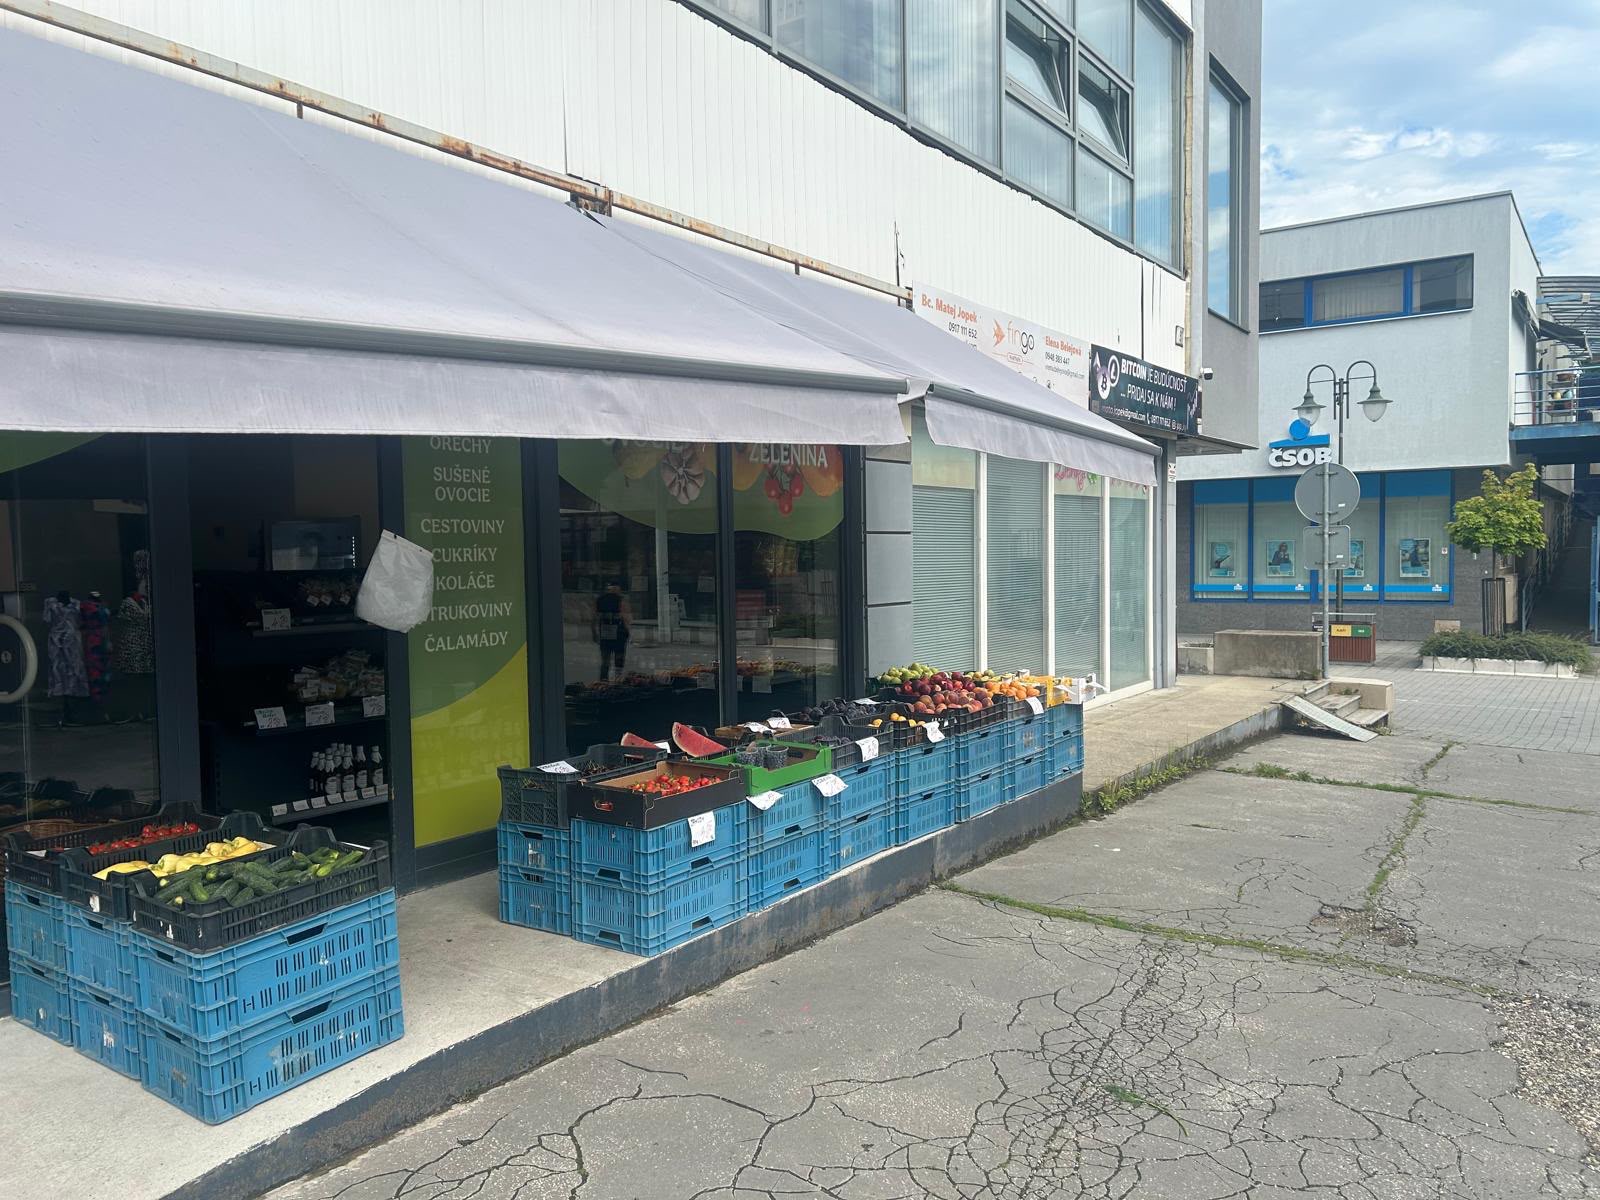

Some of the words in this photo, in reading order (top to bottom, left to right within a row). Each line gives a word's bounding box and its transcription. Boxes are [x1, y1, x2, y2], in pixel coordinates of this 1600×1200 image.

[921, 294, 934, 309] Bc.
[935, 297, 956, 319] Matej
[957, 306, 978, 324] Jopek
[1007, 320, 1035, 354] fingo
[1045, 335, 1060, 350] Elena
[1121, 358, 1148, 380] BITCOIN
[1147, 367, 1154, 382] JE
[1127, 383, 1146, 402] PRIDAJ
[1147, 390, 1155, 405] SA
[430, 436, 492, 453] ORECHY
[1268, 447, 1332, 467] ČSOB
[433, 464, 491, 483] SUŠENÉ
[435, 486, 491, 502] OVOCIE
[421, 518, 505, 534] CESTOVINY
[432, 544, 497, 562] CUKRÍKY
[436, 571, 495, 589] KOLÁČE
[430, 602, 513, 622] TRUKOVINY
[425, 629, 508, 653] ČALAMÁDY
